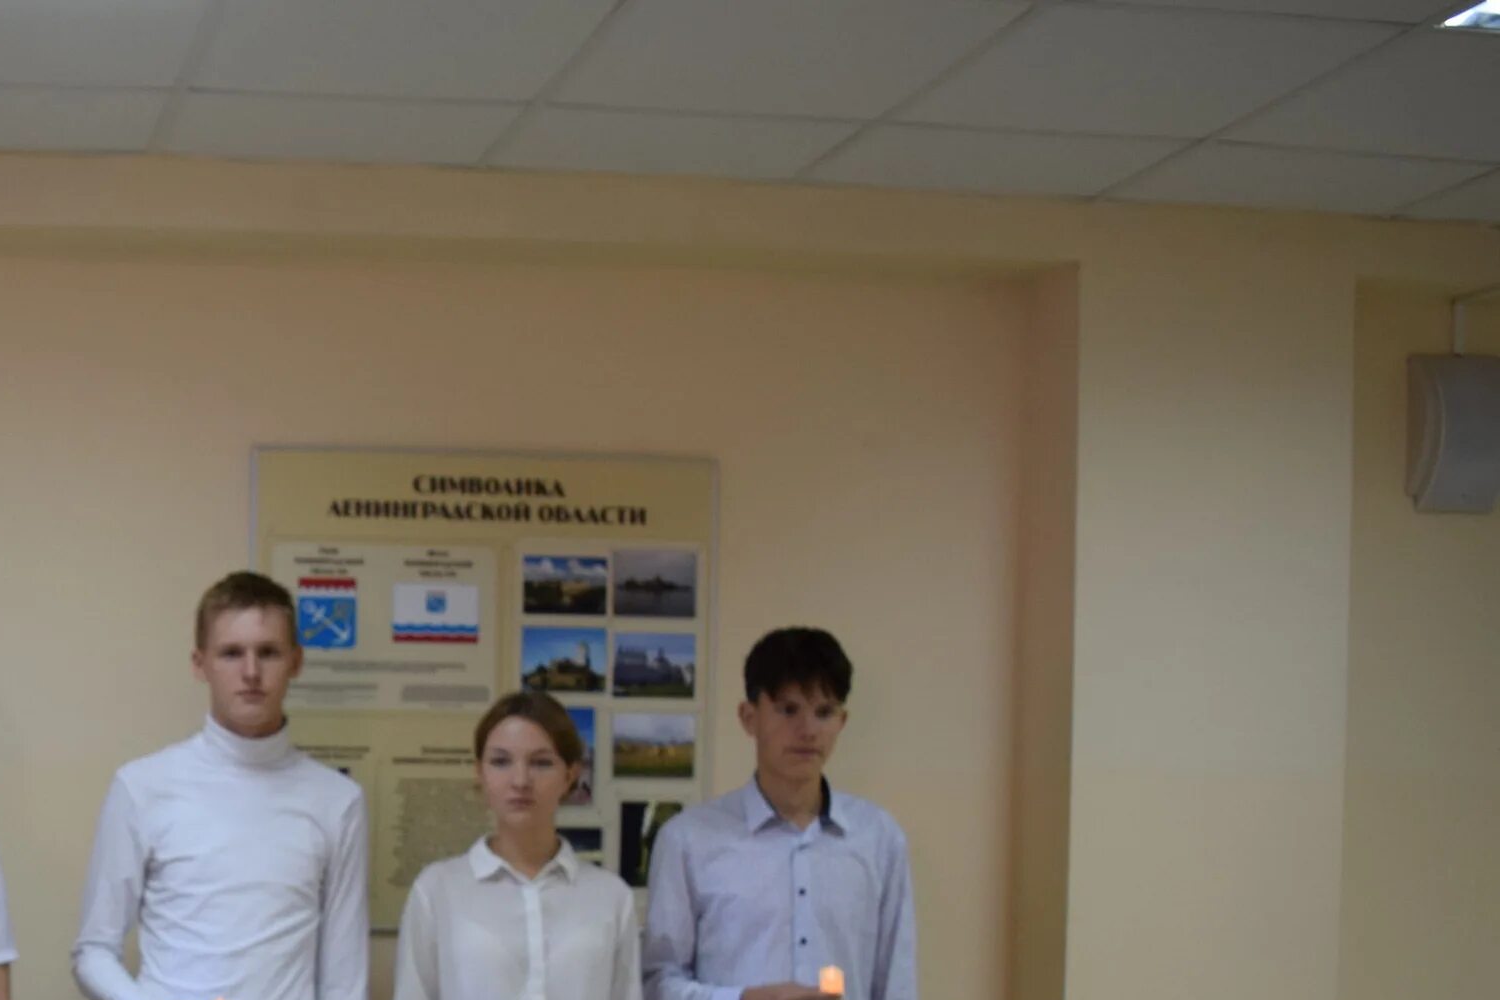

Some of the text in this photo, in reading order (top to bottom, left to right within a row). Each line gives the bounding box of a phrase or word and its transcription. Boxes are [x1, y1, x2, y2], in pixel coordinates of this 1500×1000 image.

[412, 474, 565, 498] СИМВОЛИКА
[329, 497, 647, 526] ЛЕНИНГРАДСКОЙ ОБЛАСТИ
